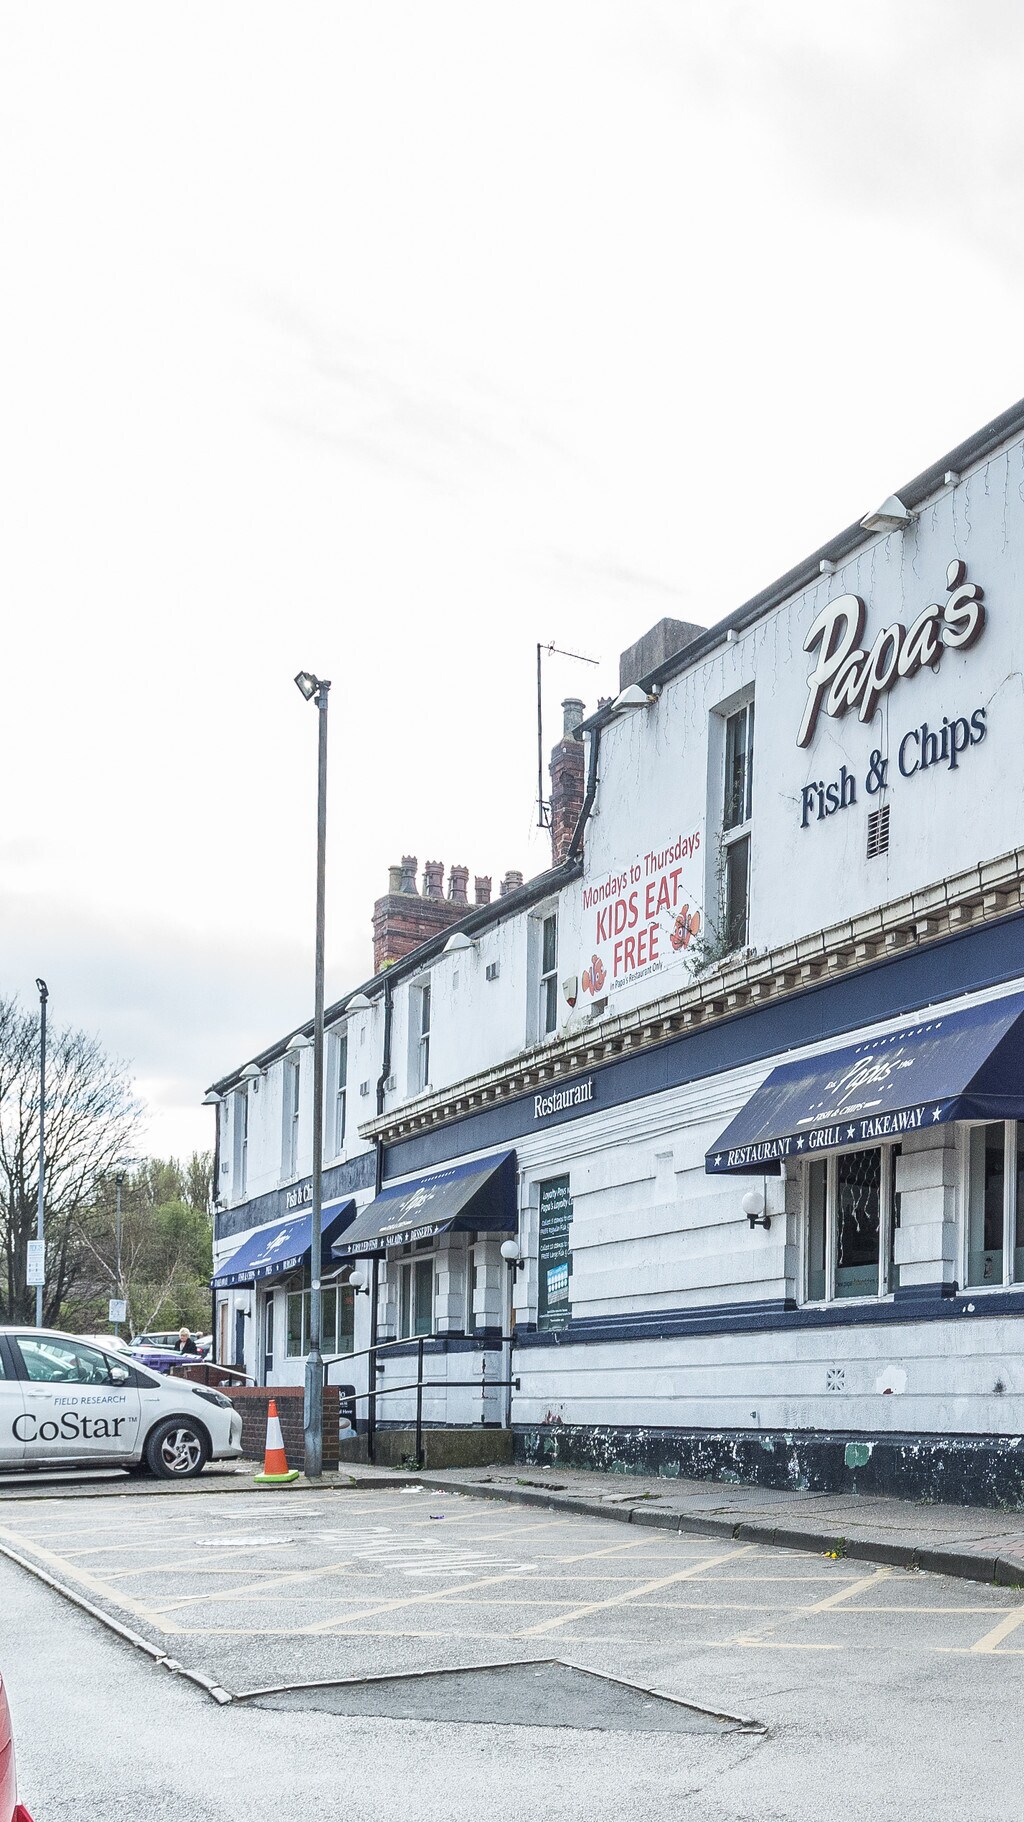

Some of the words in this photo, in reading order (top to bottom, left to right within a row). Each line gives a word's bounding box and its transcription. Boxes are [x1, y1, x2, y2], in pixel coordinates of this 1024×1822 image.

[796, 559, 985, 748] Papa's
[800, 765, 857, 828] Fish
[865, 749, 888, 794] &
[898, 707, 987, 777] Chips
[583, 872, 627, 910] Mondays
[630, 865, 641, 885] to
[644, 832, 700, 877] Thursdays
[596, 891, 638, 945] KIDS
[645, 867, 683, 920] EAT
[613, 923, 660, 978] FREE
[533, 1076, 593, 1119] Restaurant
[727, 1137, 792, 1167] RESTAURANT
[808, 1126, 841, 1149] GRILL
[860, 1107, 925, 1138] TAKEAWAY
[12, 1411, 125, 1442] CoStar
[54, 1397, 78, 1406] FIELD
[80, 1395, 126, 1405] RESEARCH
